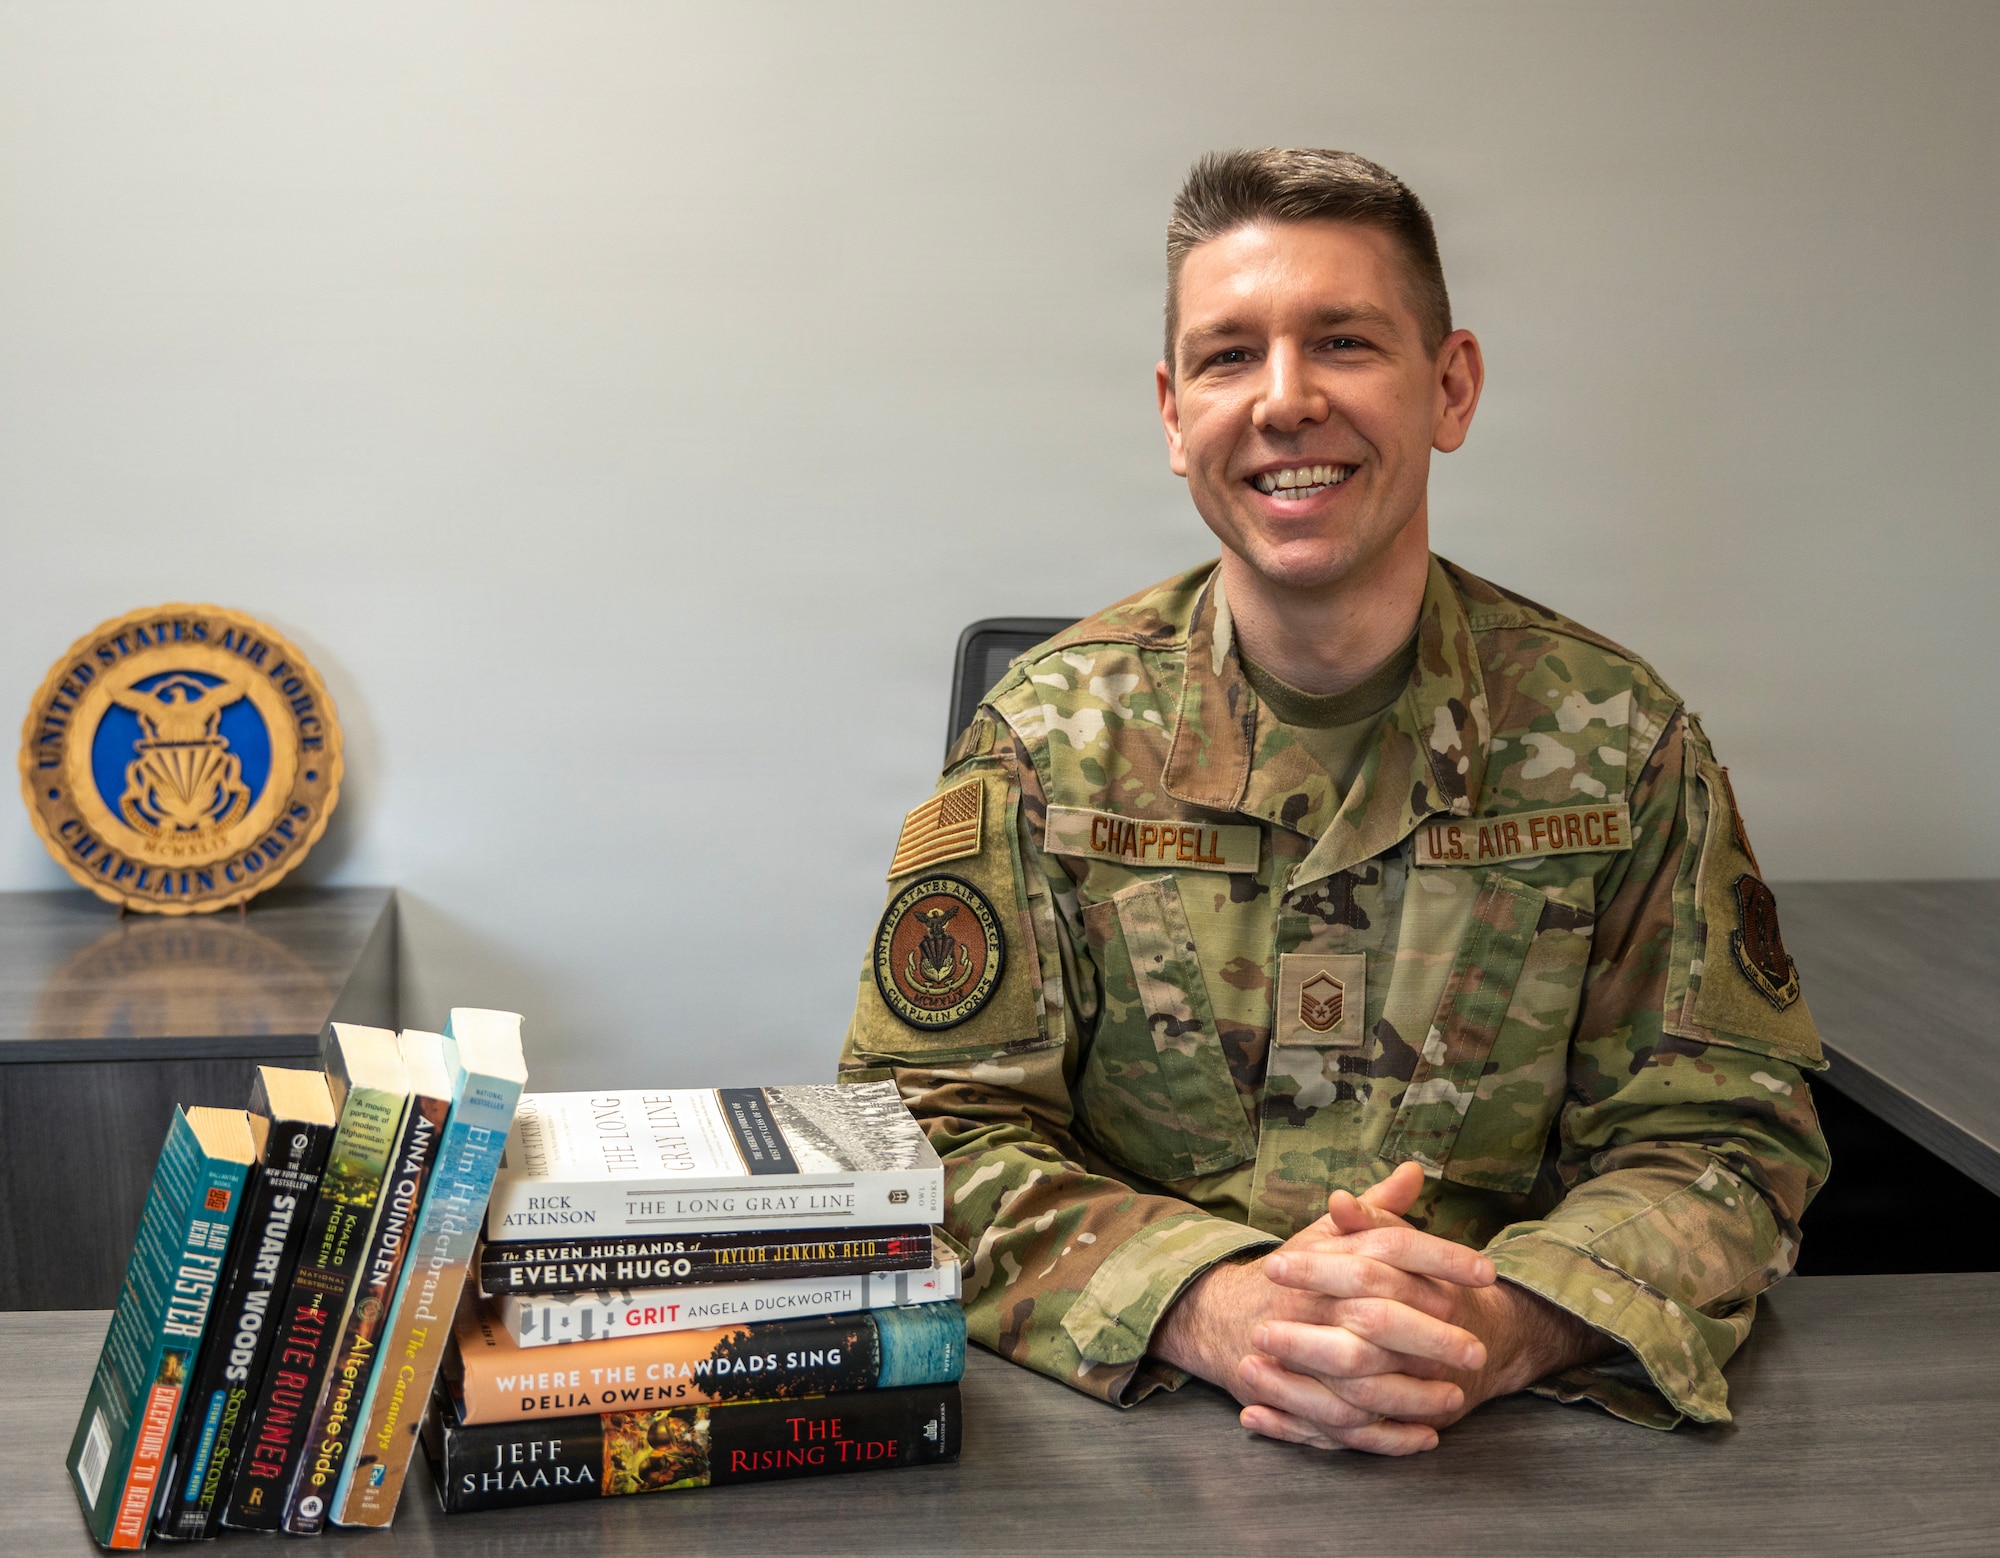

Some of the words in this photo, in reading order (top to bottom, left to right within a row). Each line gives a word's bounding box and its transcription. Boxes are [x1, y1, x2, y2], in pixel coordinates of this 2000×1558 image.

[39, 661, 96, 770] UNITED
[96, 619, 210, 668] STATES
[217, 627, 272, 667] AIR
[268, 661, 324, 755] FORCE
[60, 817, 216, 896] CHAPLAIN
[224, 800, 311, 884] CORPS
[1089, 814, 1226, 865] CHAPPELL
[1427, 825, 1470, 860] U.S.
[1478, 820, 1522, 859] AIR
[1530, 810, 1620, 852] FORCE
[879, 908, 900, 966] UNITED
[901, 881, 948, 907] STATES
[952, 884, 975, 903] AIR
[975, 905, 999, 952] FORCE
[886, 988, 950, 1022] CHAPLAIN
[956, 977, 992, 1017] CORPS
[365, 1102, 392, 1115] moving
[470, 1097, 505, 1111] BESTSELLER
[475, 1088, 504, 1101] NATIONAL
[748, 1100, 760, 1111] 1966
[349, 1109, 379, 1122] portrait
[517, 1098, 544, 1150] ATKINSON
[590, 1097, 629, 1139] LONG
[642, 1095, 681, 1129] LINE
[734, 1110, 753, 1129] JOURNEY
[755, 1118, 769, 1132] CLASS
[352, 1120, 382, 1133] modern
[742, 1128, 761, 1151] AMERICAN
[403, 1115, 435, 1174] ANNA
[457, 1124, 491, 1173] Elin
[654, 1135, 696, 1171] GRAY
[769, 1148, 782, 1161] WEST
[287, 1161, 300, 1171] THE
[524, 1153, 549, 1177] RICK
[602, 1145, 639, 1173] THE
[265, 1167, 281, 1177] NEW
[281, 1170, 298, 1180] YORK
[299, 1171, 319, 1183] TIMES
[270, 1178, 309, 1191] BESTSELLER
[207, 1198, 228, 1210] REY
[209, 1188, 227, 1201] DEL
[528, 1196, 572, 1211] RICK
[626, 1201, 666, 1215] THE
[677, 1198, 736, 1213] LONG
[746, 1196, 799, 1211] GRAY
[810, 1194, 856, 1208] LINE
[502, 1210, 597, 1226] ATKINSON
[187, 1219, 211, 1247] DEAN
[206, 1222, 230, 1250] ALAN
[252, 1194, 297, 1285] STUART
[316, 1204, 345, 1269] HOSSEINI
[333, 1213, 357, 1265] KHALED
[369, 1179, 416, 1287] QUINDLEN
[415, 1181, 475, 1322] Hilderbrand
[501, 1252, 520, 1261] The
[525, 1246, 584, 1262] SEVEN
[590, 1241, 685, 1260] HUSBANDS
[690, 1241, 702, 1251] of
[715, 1247, 766, 1265] TAYLOR
[774, 1243, 836, 1262] JENKINS
[843, 1241, 876, 1257] REID
[296, 1276, 344, 1293] BESTSELLER
[299, 1269, 346, 1285] NATIONAL
[510, 1261, 607, 1286] EVELYN
[617, 1258, 692, 1280] HUGO
[162, 1251, 222, 1338] FOSTER
[309, 1292, 323, 1317] THE
[687, 1300, 750, 1318] ANGELA
[754, 1289, 853, 1311] DUCKWORTH
[625, 1304, 680, 1327] GRIT
[225, 1290, 271, 1381] WOODS
[282, 1305, 329, 1368] KITE
[405, 1327, 428, 1359] The
[496, 1370, 580, 1392] WHERE
[590, 1366, 636, 1385] THE
[646, 1353, 778, 1380] CRAWDADS
[786, 1348, 842, 1369] SING
[325, 1334, 374, 1436] Alternate
[521, 1393, 591, 1411] DELIA
[601, 1384, 687, 1404] OWENS
[208, 1403, 221, 1424] STONE
[223, 1388, 247, 1425] SON
[376, 1365, 414, 1450] Castaways
[139, 1386, 177, 1460] EXCEPTIONS
[220, 1428, 230, 1443] OF
[249, 1370, 309, 1480] RUNNER
[785, 1417, 842, 1443] THE
[196, 1427, 214, 1472] BARRINGTON
[311, 1439, 344, 1486] Side
[495, 1439, 562, 1470] JEFF
[133, 1465, 156, 1481] TO
[188, 1474, 201, 1495] NOVEL
[200, 1446, 230, 1505] STONE
[462, 1464, 596, 1493] SHAARA
[119, 1485, 150, 1537] REALITY
